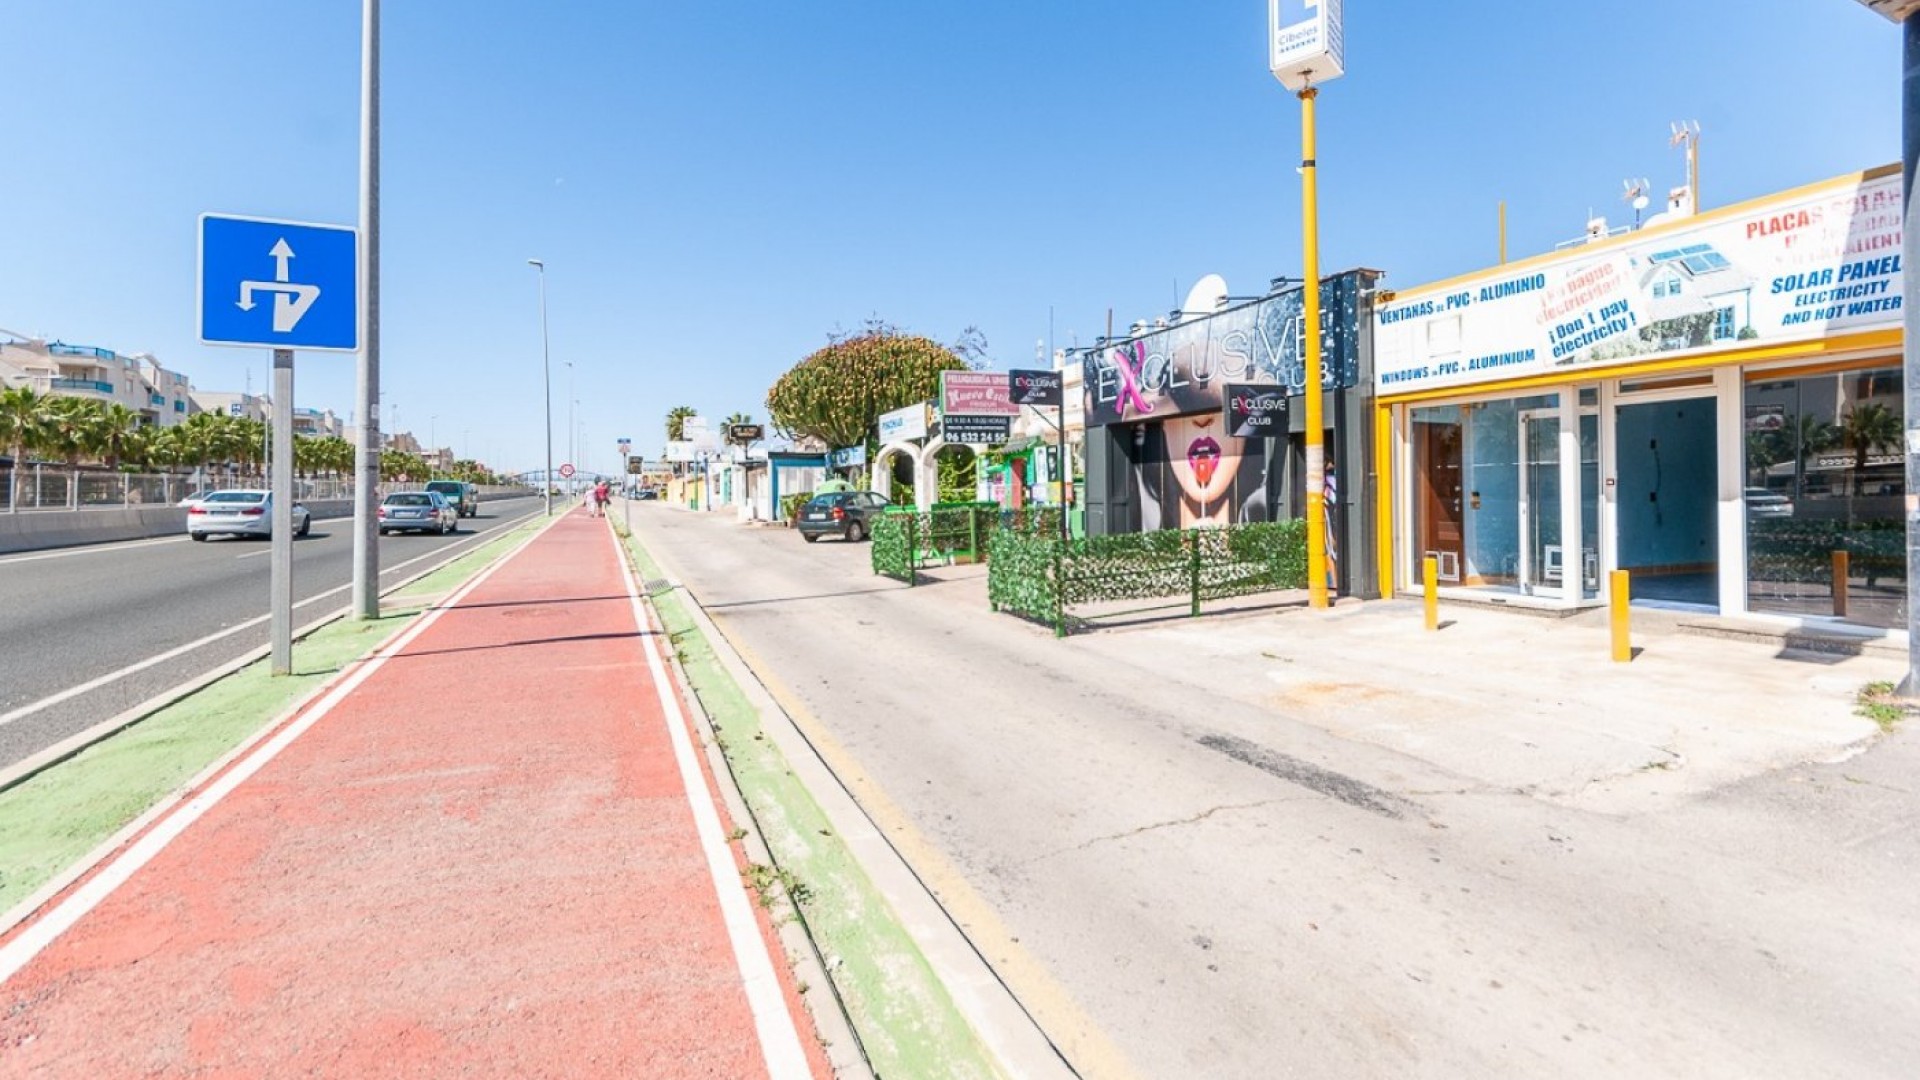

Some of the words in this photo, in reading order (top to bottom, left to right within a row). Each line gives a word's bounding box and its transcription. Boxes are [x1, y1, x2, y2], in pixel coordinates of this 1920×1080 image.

[1278, 25, 1318, 45] Cibeles
[1770, 268, 1833, 295] SOLAR
[1838, 255, 1903, 283] PANEL
[1380, 301, 1434, 325] VENTANAS
[1446, 292, 1470, 310] PVC
[1480, 273, 1546, 303] ALUMINIO
[1794, 280, 1890, 307] ELECTRICITY
[1599, 296, 1630, 321] pay
[1782, 311, 1812, 326] AND
[1815, 303, 1845, 322] HOT
[1848, 296, 1903, 317] WATER
[1381, 366, 1429, 385] WINDOWS
[1439, 361, 1459, 376] PVC
[1468, 349, 1535, 372] ALUMINIUM
[1231, 394, 1286, 416] EXCLUSIVE
[1247, 416, 1272, 425] CLUB
[946, 432, 960, 443] 96
